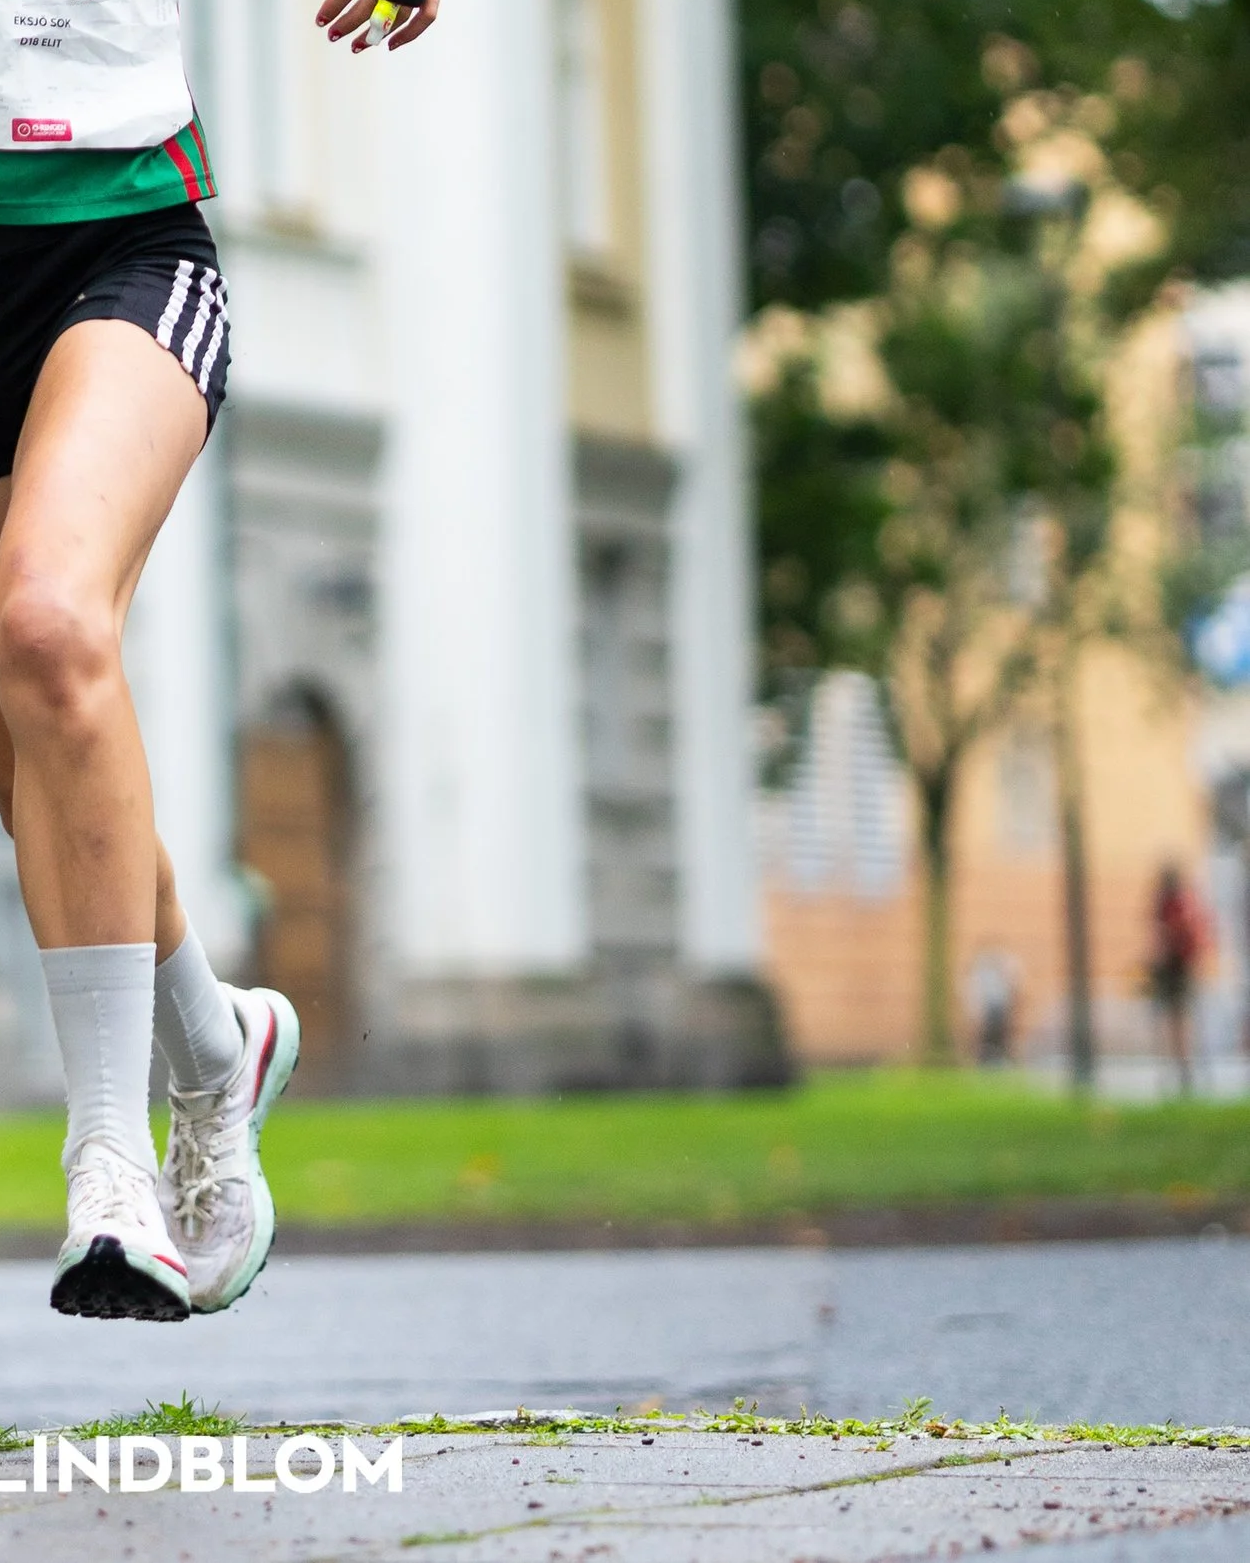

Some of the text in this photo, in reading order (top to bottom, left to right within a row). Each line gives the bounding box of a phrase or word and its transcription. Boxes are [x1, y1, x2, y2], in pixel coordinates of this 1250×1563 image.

[14, 15, 71, 28] EKSJÖ SOK
[20, 37, 63, 48] D18 ELIT
